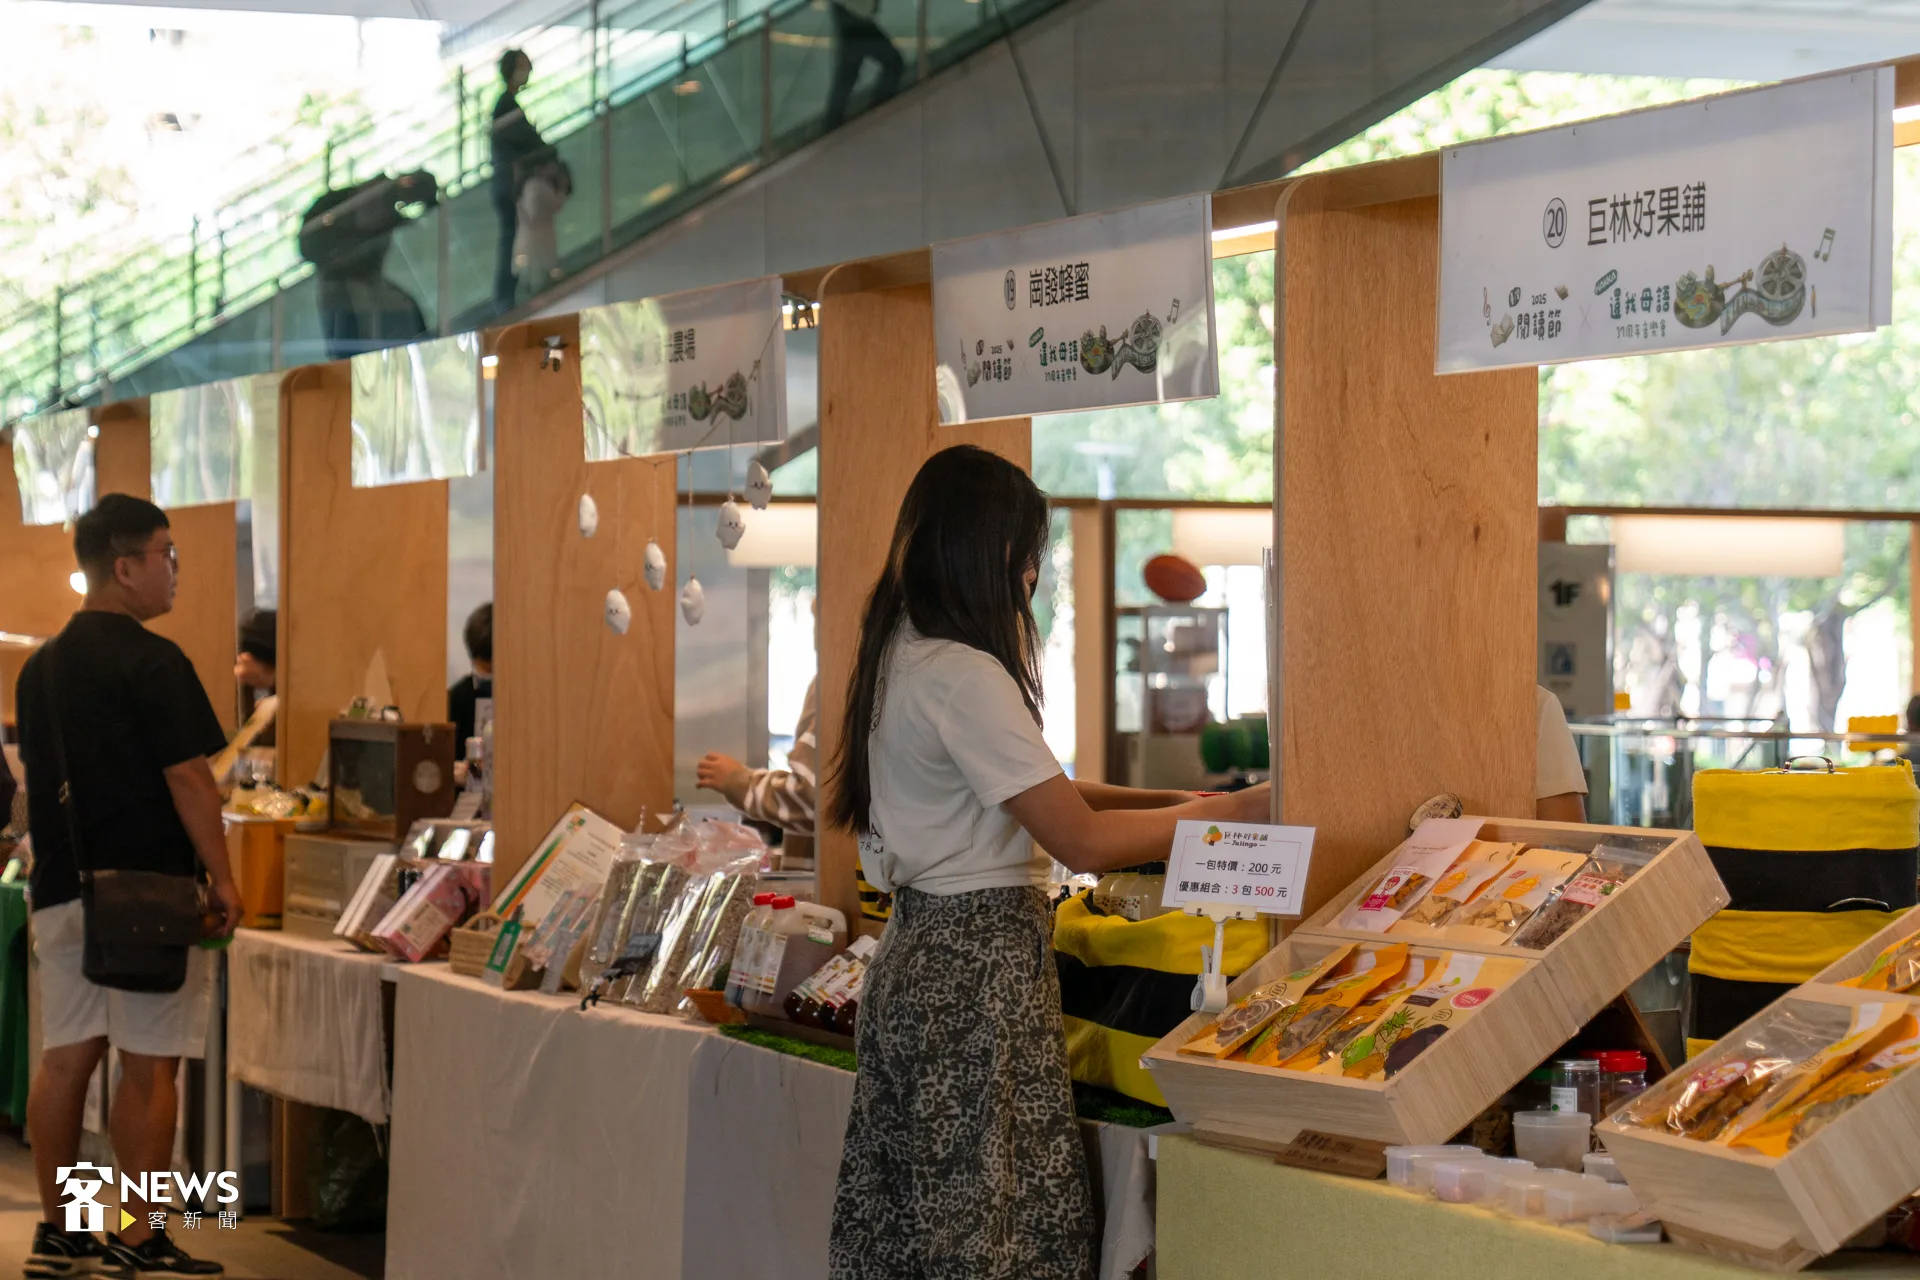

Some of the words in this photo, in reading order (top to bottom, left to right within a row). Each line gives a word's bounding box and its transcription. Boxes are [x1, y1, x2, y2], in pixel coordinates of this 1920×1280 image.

[1546, 205, 1565, 240] 20
[1587, 180, 1706, 246] 巨林好果舖
[1029, 261, 1090, 309] 崗發蜂蜜
